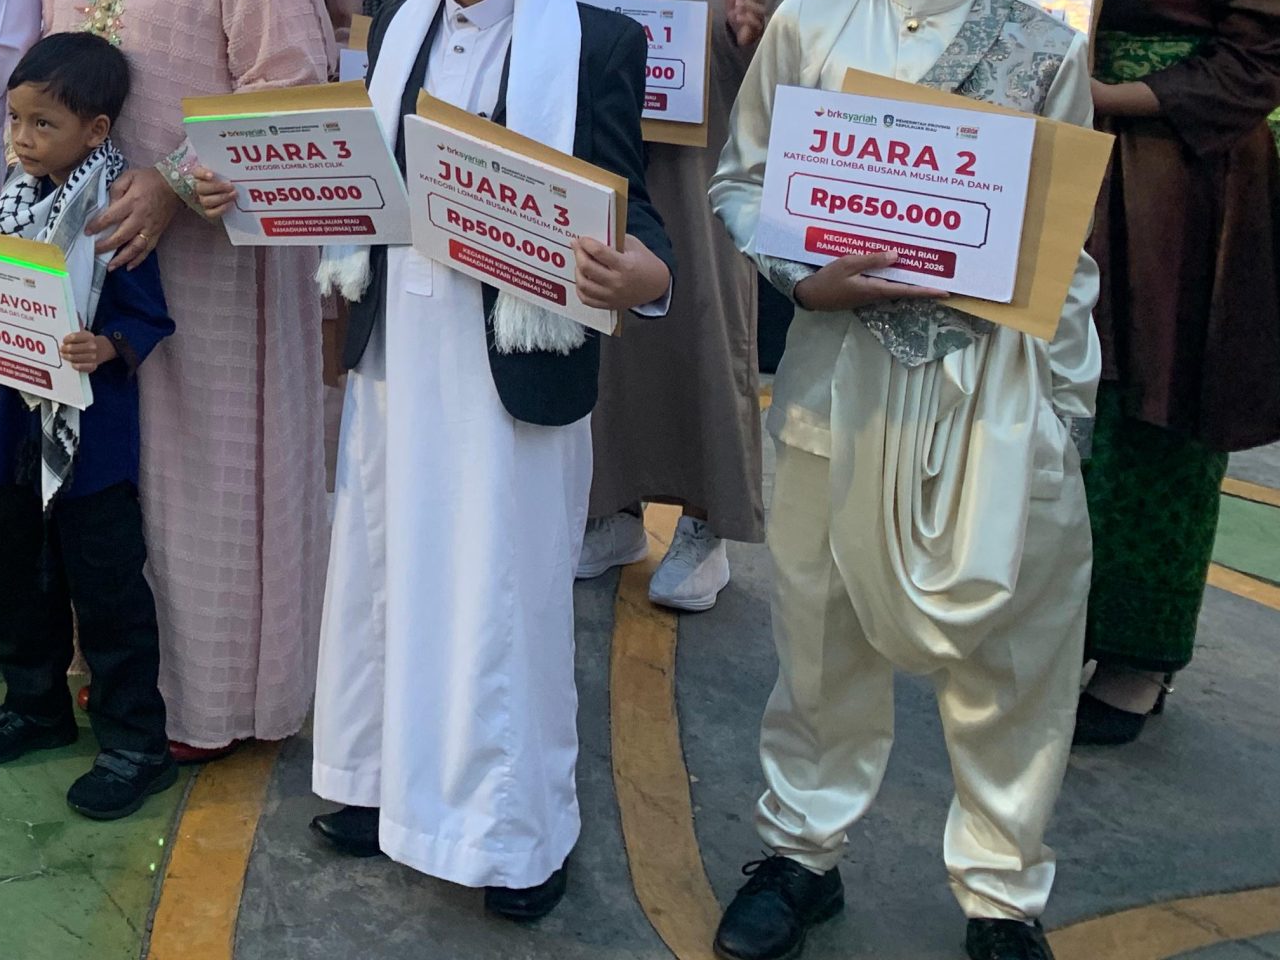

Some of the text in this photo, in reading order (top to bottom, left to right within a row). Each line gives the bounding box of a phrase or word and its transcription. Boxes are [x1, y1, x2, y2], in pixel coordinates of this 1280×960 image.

[663, 26, 672, 43] 1
[827, 109, 878, 126] brksyariah
[226, 140, 352, 164] JUARA 3
[809, 129, 940, 172] JUARA
[955, 150, 977, 177] 2
[783, 151, 1004, 193] KATEGORI LOMBA BUSANA MUSLIM PA DAN PI
[248, 185, 363, 206] Rp500.000
[419, 173, 456, 192] KATEGORI
[457, 188, 484, 204] LOMBA
[486, 199, 518, 217] BUSANA
[519, 212, 551, 231] MUSLIM
[552, 225, 564, 235] PA
[438, 160, 542, 218] JUARA
[553, 203, 570, 227] 3
[809, 187, 962, 231] Rp650.000
[446, 208, 566, 269] Rp500.000
[823, 233, 865, 247] KEGIATAN
[865, 242, 917, 257] KEPULAUAN
[917, 250, 940, 261] RIAU
[816, 242, 865, 256] RAMADHAN
[923, 262, 945, 272] 2026
[541, 288, 559, 300] 2026
